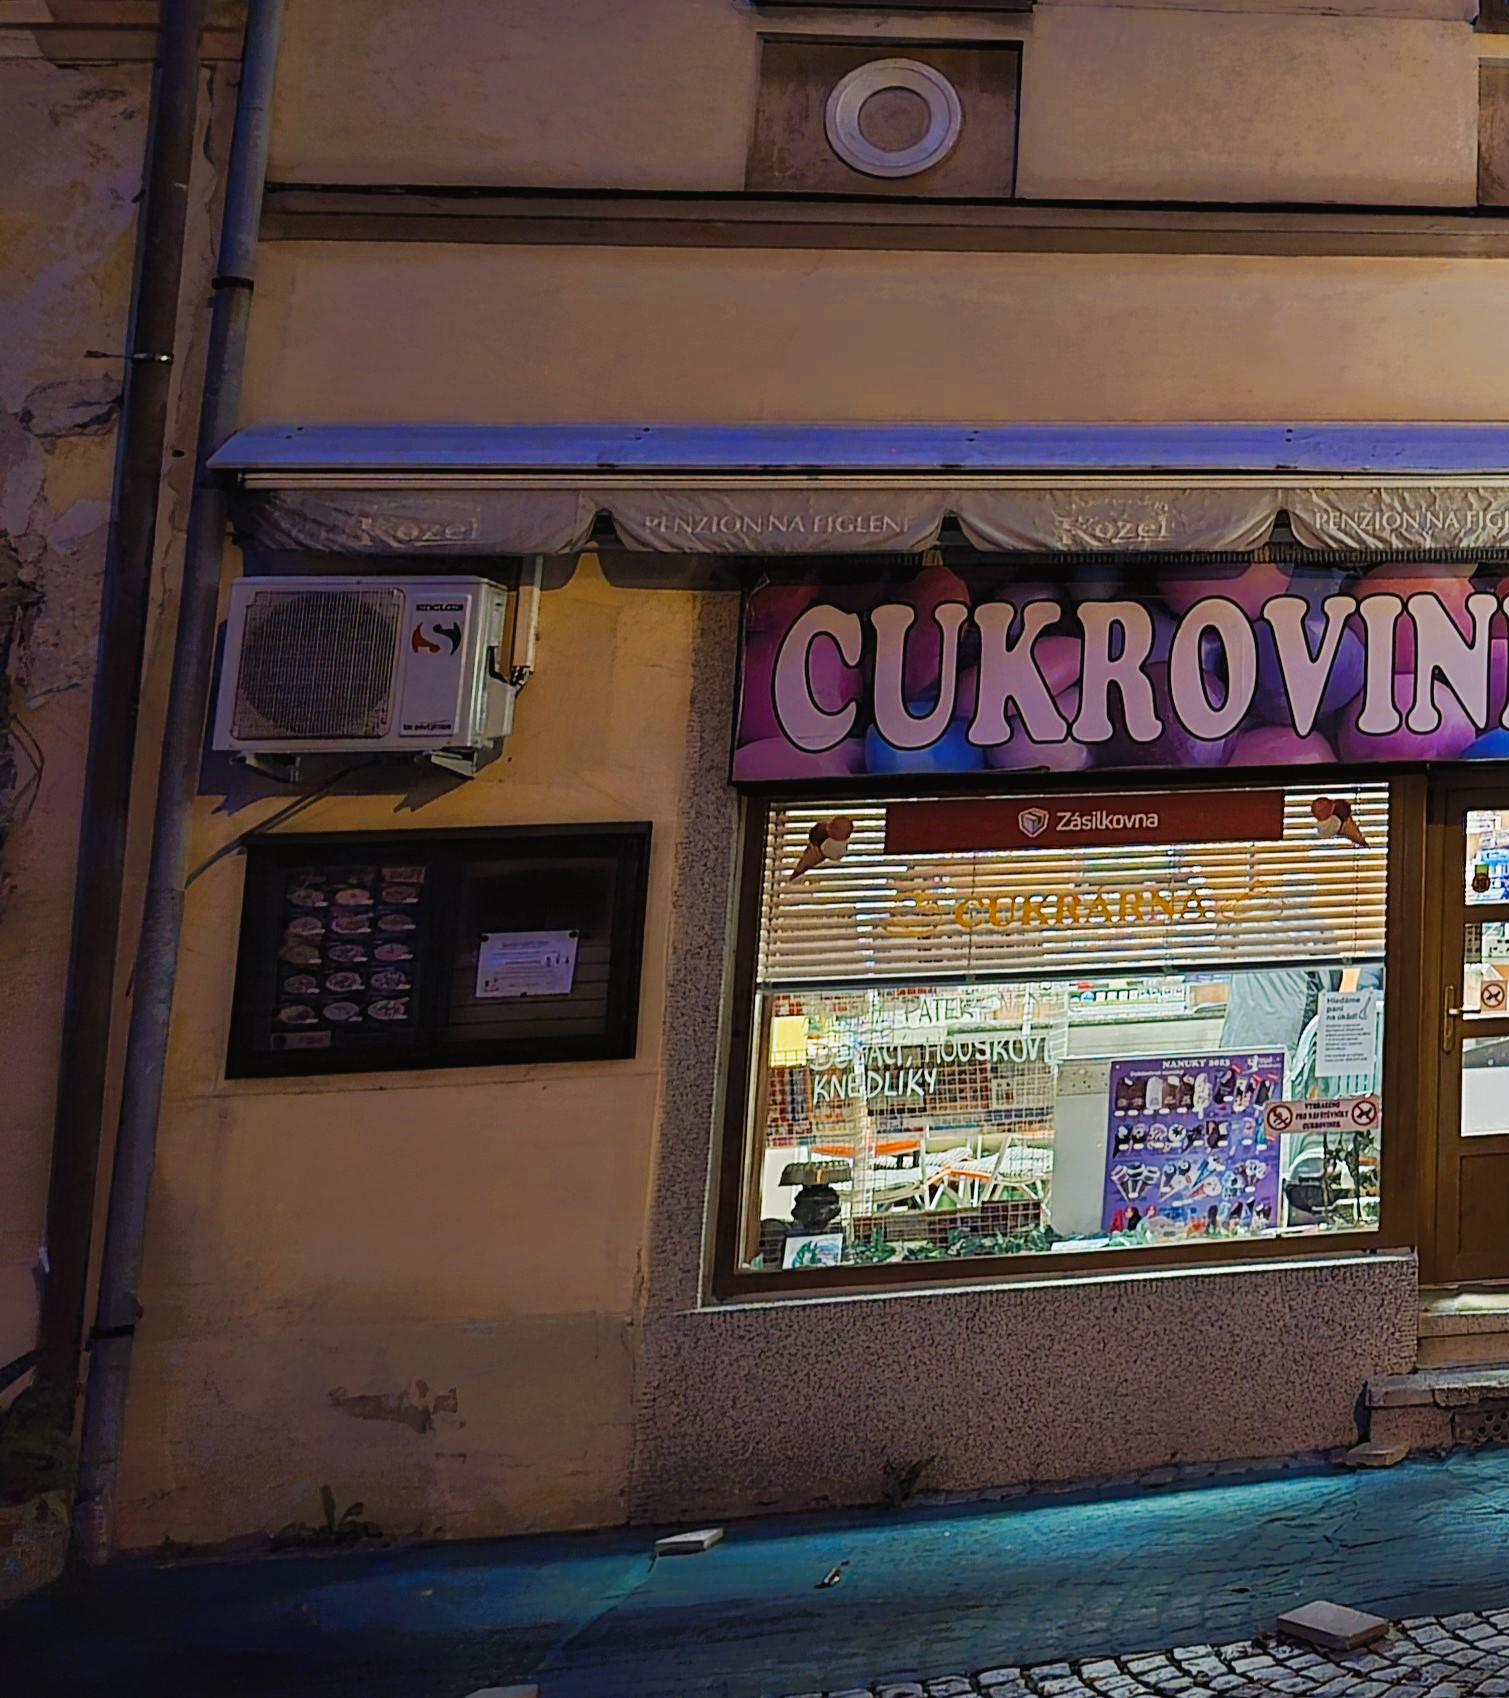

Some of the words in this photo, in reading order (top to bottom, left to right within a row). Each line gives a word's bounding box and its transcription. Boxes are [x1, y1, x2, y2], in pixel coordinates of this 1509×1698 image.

[767, 514, 805, 534] NA
[1315, 510, 1420, 531] PENZION
[1426, 510, 1460, 531] NA
[1055, 809, 1160, 832] Zásilkovna
[1162, 1058, 1207, 1070] NANUKY
